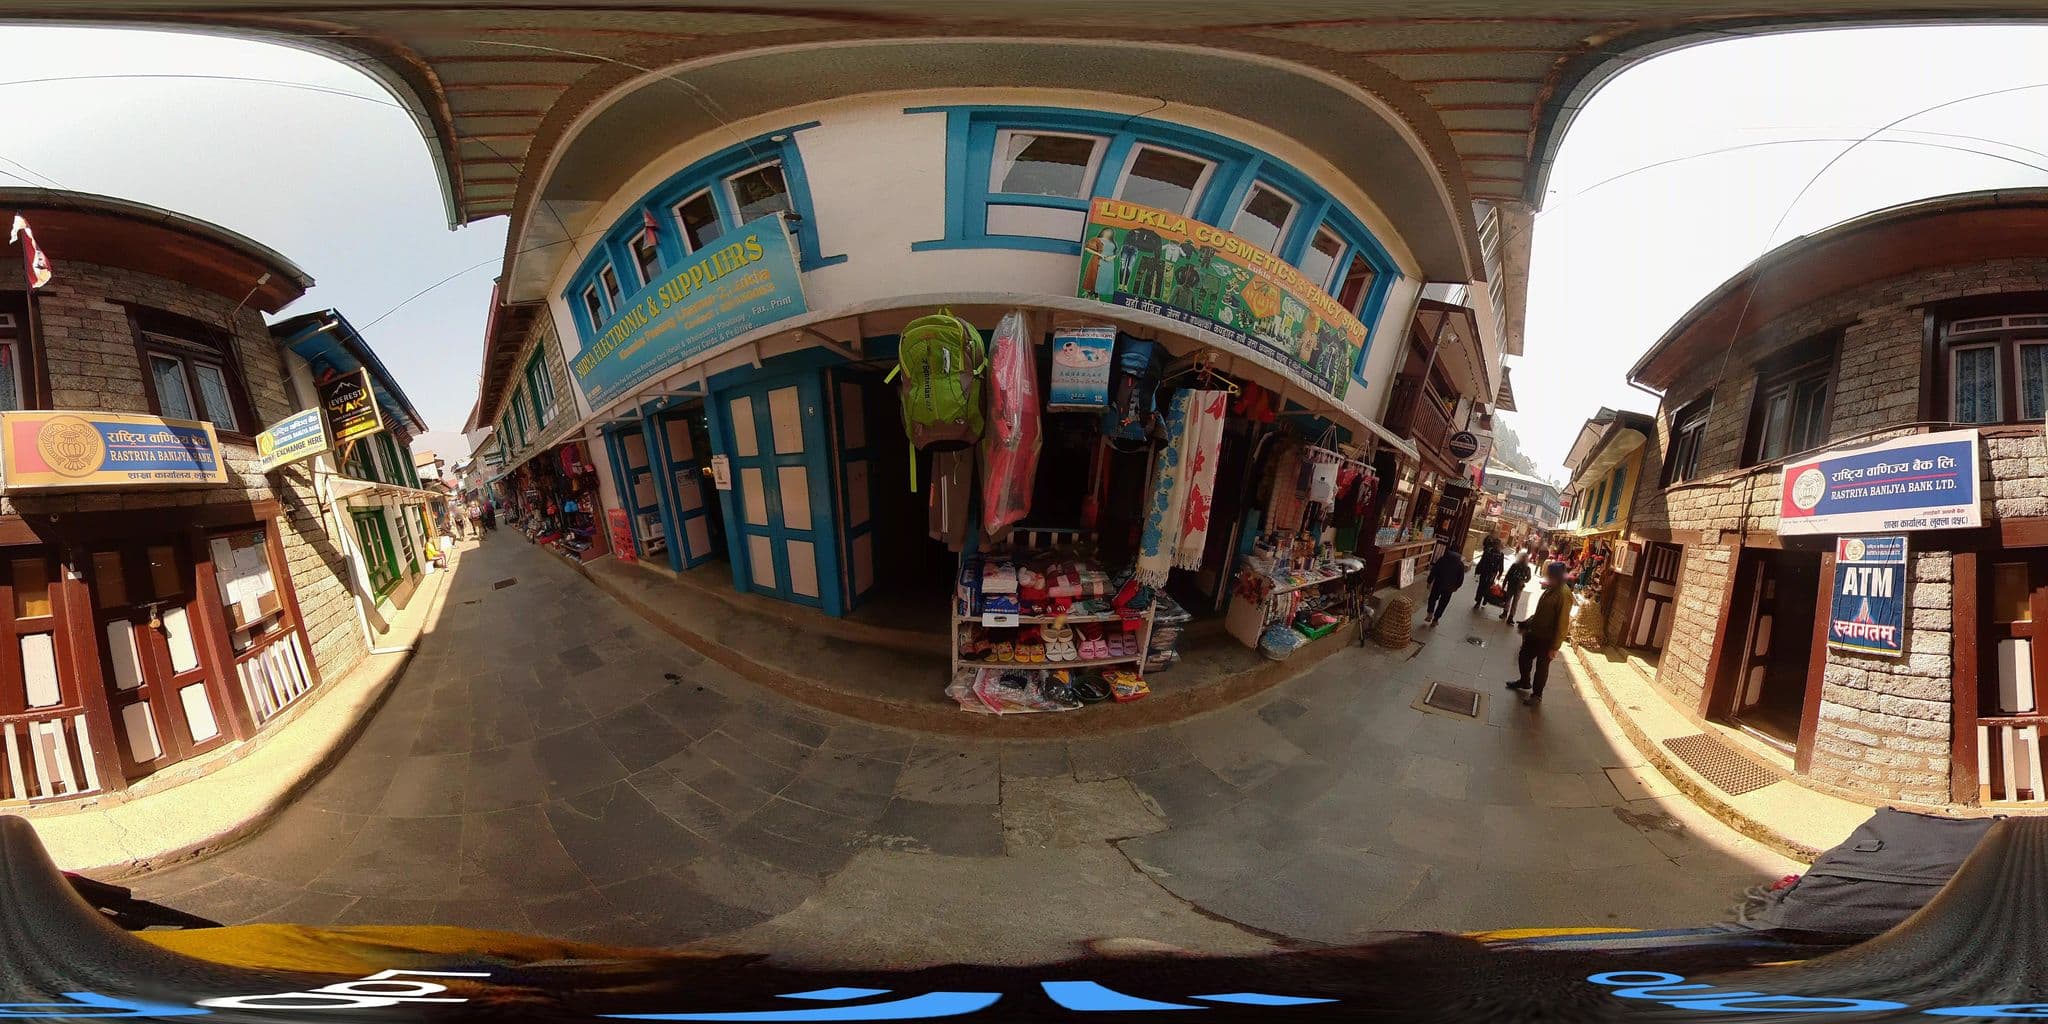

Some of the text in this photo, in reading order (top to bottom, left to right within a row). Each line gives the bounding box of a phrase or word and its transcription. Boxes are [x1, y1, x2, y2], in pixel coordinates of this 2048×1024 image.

[1101, 201, 1188, 236] LUKLA
[1195, 227, 1297, 284] COSMETICS
[1307, 285, 1342, 320] FANCY
[1342, 313, 1366, 340] SHOP
[575, 351, 598, 381] SURYA
[592, 303, 649, 368] ELECTRONIC
[647, 296, 662, 318] &
[658, 234, 764, 309] SUPPLIERS
[331, 390, 362, 406] EVEREST
[110, 450, 212, 463] RASTRIYA BANIJYA BANK
[276, 441, 305, 457] EXCHANGE
[307, 435, 323, 446] HERE
[1831, 479, 1957, 500] RASTRIYA BANIJYA BANK LTD.
[1842, 567, 1893, 598] ATM
